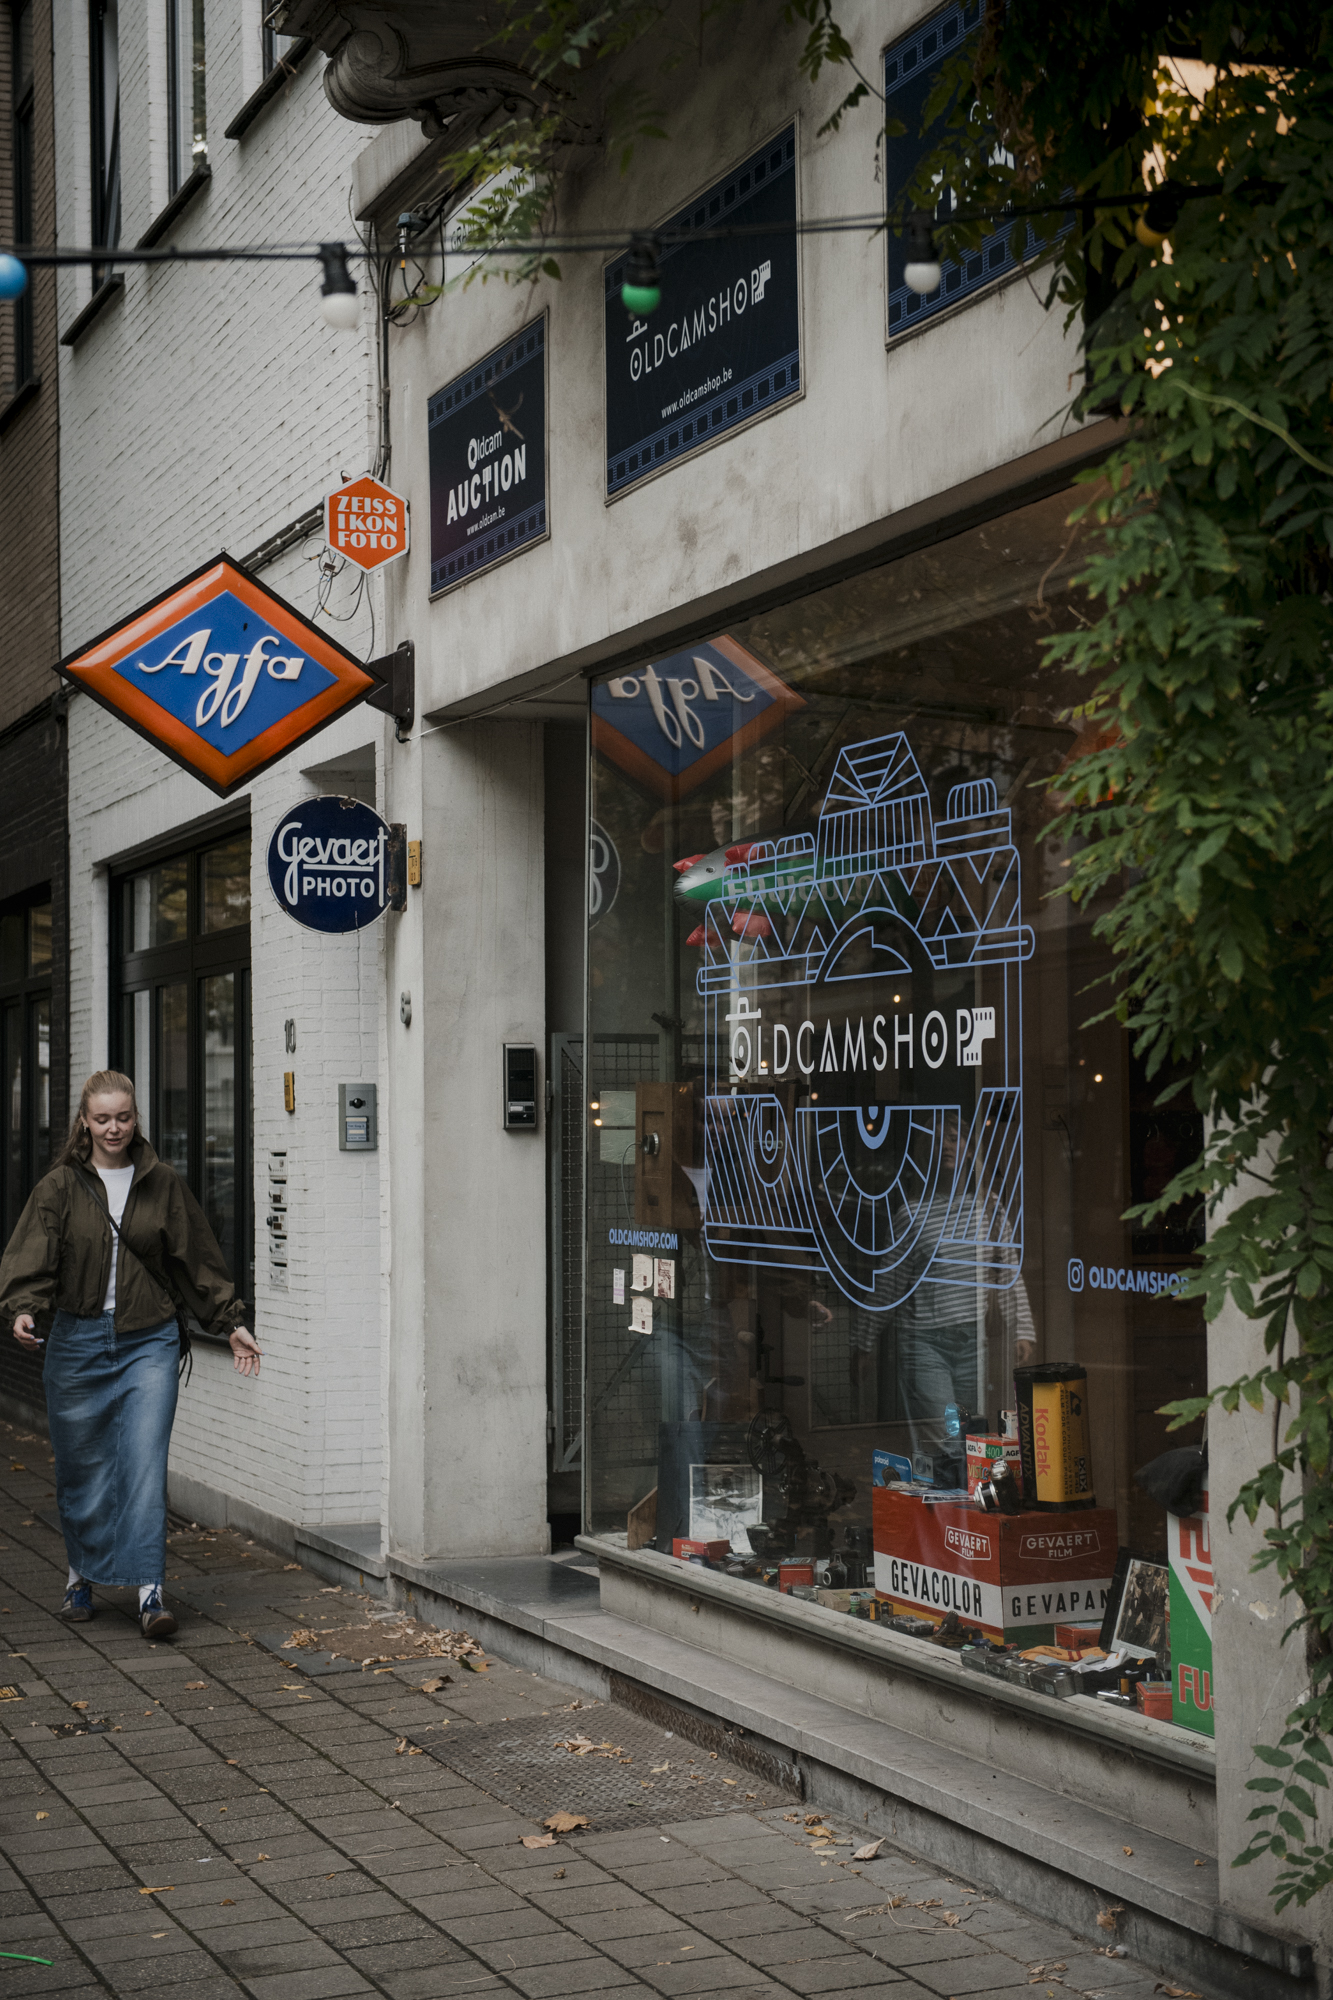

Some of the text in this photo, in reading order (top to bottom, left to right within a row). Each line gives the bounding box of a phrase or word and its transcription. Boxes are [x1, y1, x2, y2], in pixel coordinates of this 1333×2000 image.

[629, 260, 771, 382] OLDCAMSHOP
[661, 367, 733, 419] www.oldcamshop.be
[467, 430, 503, 471] Oldcam
[446, 443, 526, 526] AUCTION
[337, 495, 397, 515] ZEISS
[466, 505, 506, 536] www.oldcam.be
[338, 513, 397, 533] IKON
[338, 531, 397, 550] FOTO
[138, 628, 305, 729] Agfa
[277, 821, 388, 908] Gevaert
[302, 876, 375, 898] PHOTO
[400, 991, 412, 1025] 8
[730, 1006, 996, 1078] OLDCAMSHOP
[608, 1228, 679, 1250] OLDCAMSHOP.COM
[986, 1446, 1001, 1458] 400
[1034, 1408, 1051, 1477] Kodak
[947, 1529, 988, 1553] GEVAERT
[961, 1547, 975, 1558] FILM
[1026, 1533, 1093, 1550] GEVAERT
[1048, 1548, 1073, 1558] FILM
[891, 1559, 983, 1618] GEVACOLOR
[1178, 1662, 1214, 1712] FU
